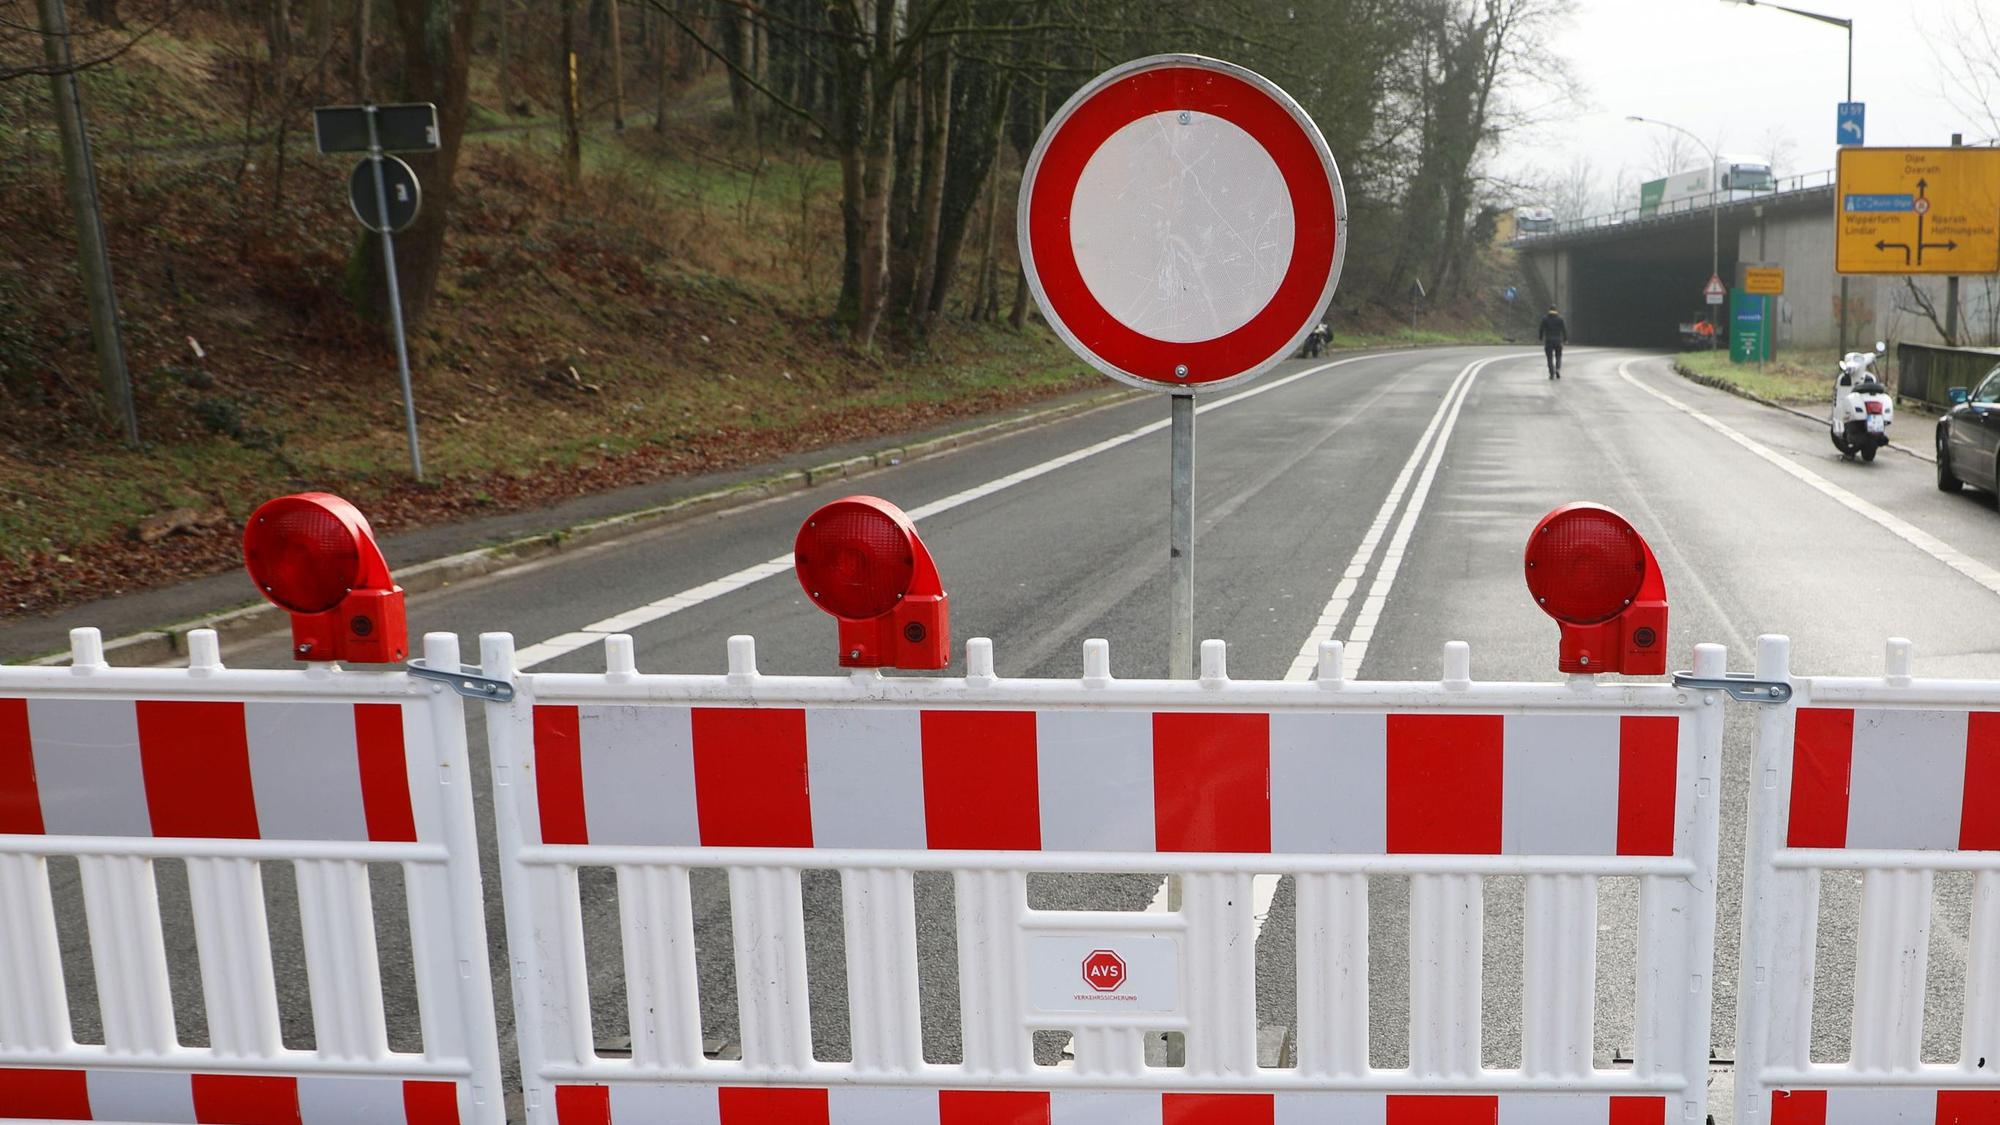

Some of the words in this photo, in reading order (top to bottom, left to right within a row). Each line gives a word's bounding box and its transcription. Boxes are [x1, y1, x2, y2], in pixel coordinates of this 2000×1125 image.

[1904, 165, 1941, 174] Overath
[1845, 226, 1876, 236] Lindlar
[1090, 965, 1119, 977] AVS
